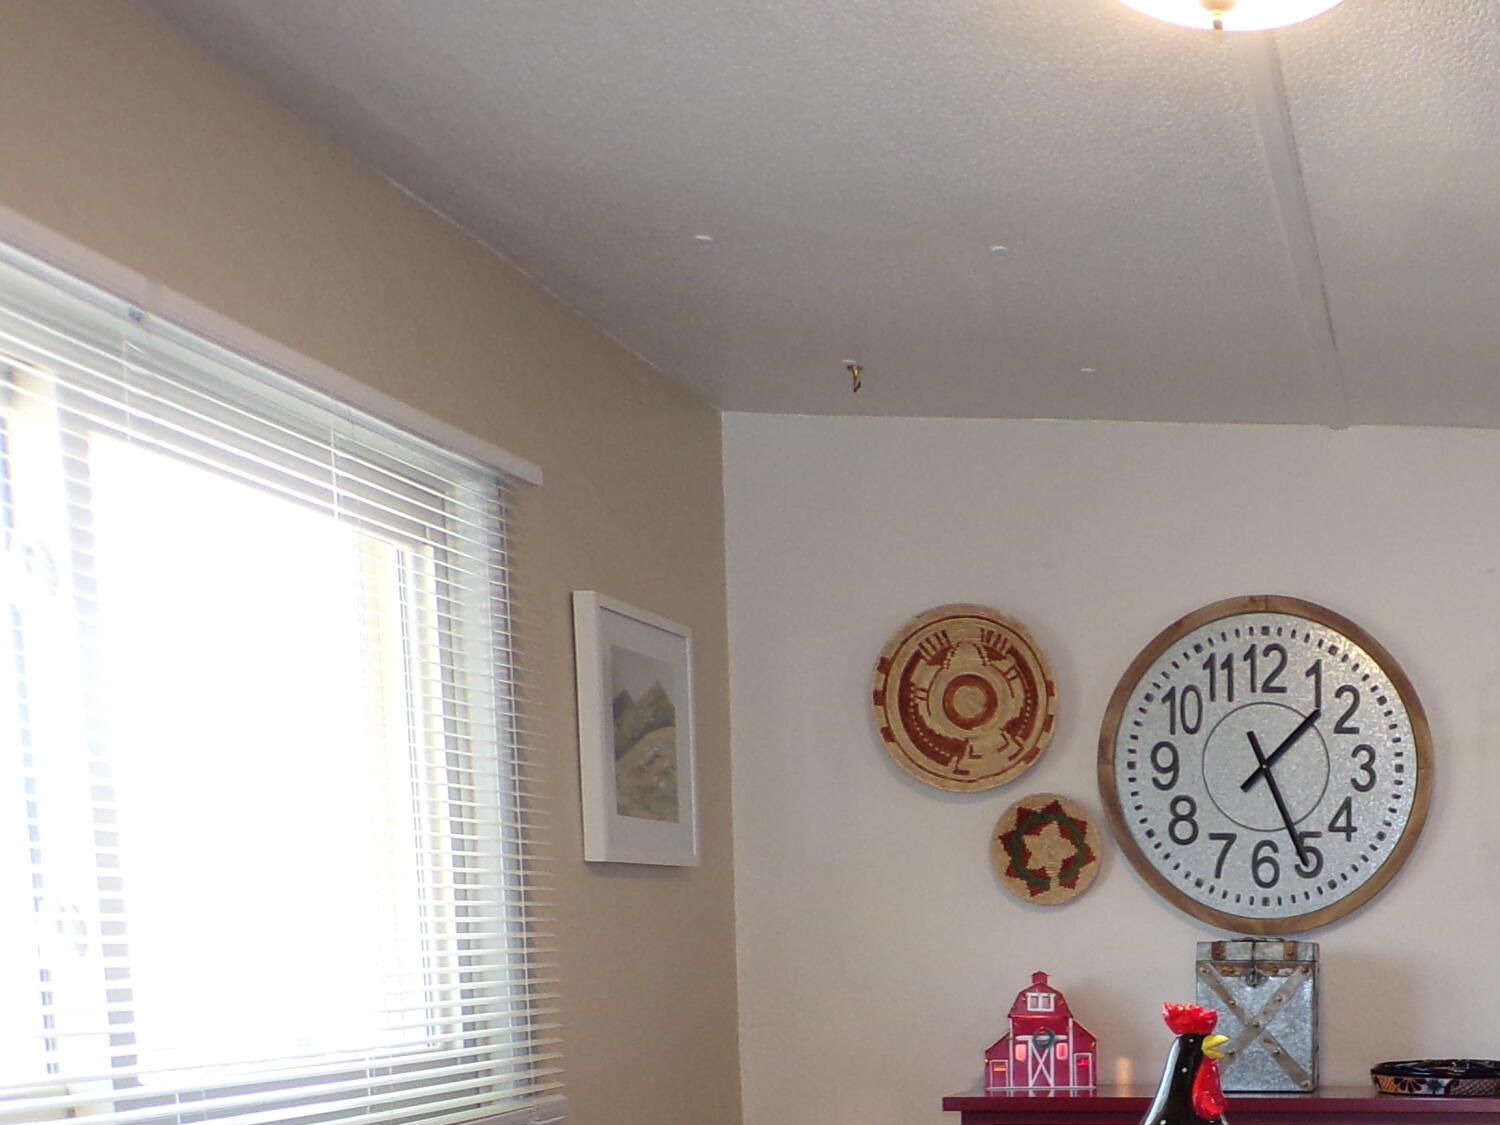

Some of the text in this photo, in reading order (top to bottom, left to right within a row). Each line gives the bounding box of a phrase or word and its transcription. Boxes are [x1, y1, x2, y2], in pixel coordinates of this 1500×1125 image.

[1202, 653, 1235, 702] 11
[1243, 643, 1287, 693] 12
[1305, 659, 1322, 709] 1
[1161, 684, 1203, 735] 10
[1334, 685, 1361, 734] 2
[1150, 741, 1179, 791] 9
[1351, 744, 1377, 792] 3
[1168, 795, 1199, 845] 8
[1328, 796, 1357, 842] 4
[1208, 833, 1237, 879] 7
[1251, 840, 1280, 889] 6
[1294, 832, 1324, 879] 5
